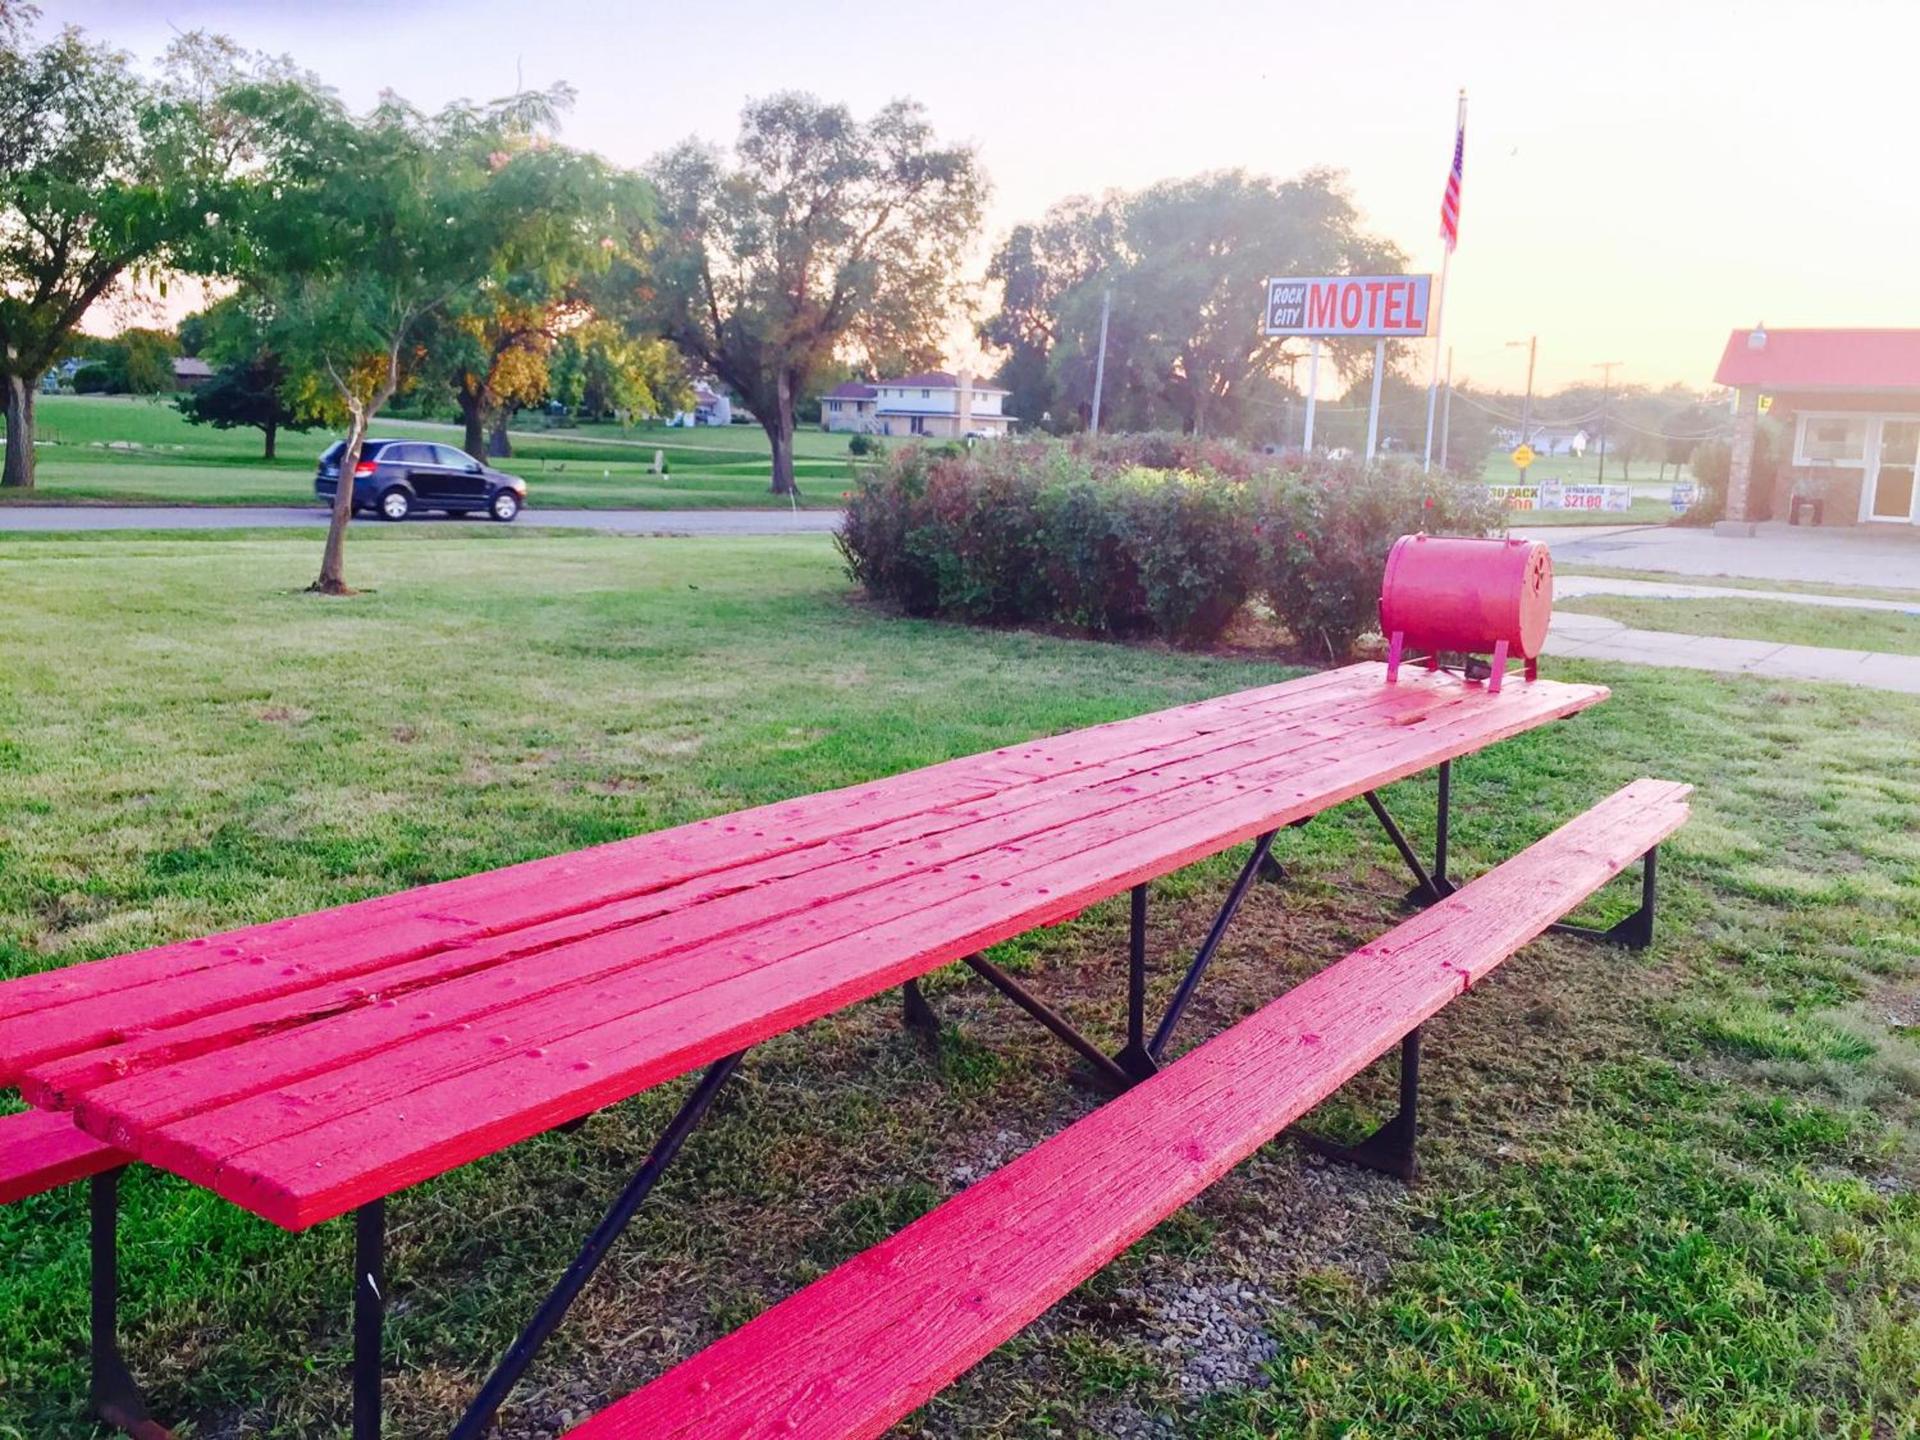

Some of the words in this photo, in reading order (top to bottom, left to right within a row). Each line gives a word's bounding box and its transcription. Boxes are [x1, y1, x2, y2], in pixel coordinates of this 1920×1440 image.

[1273, 287, 1304, 304] ROCK
[1307, 282, 1423, 328] MOTEL
[1274, 308, 1300, 326] CITY
